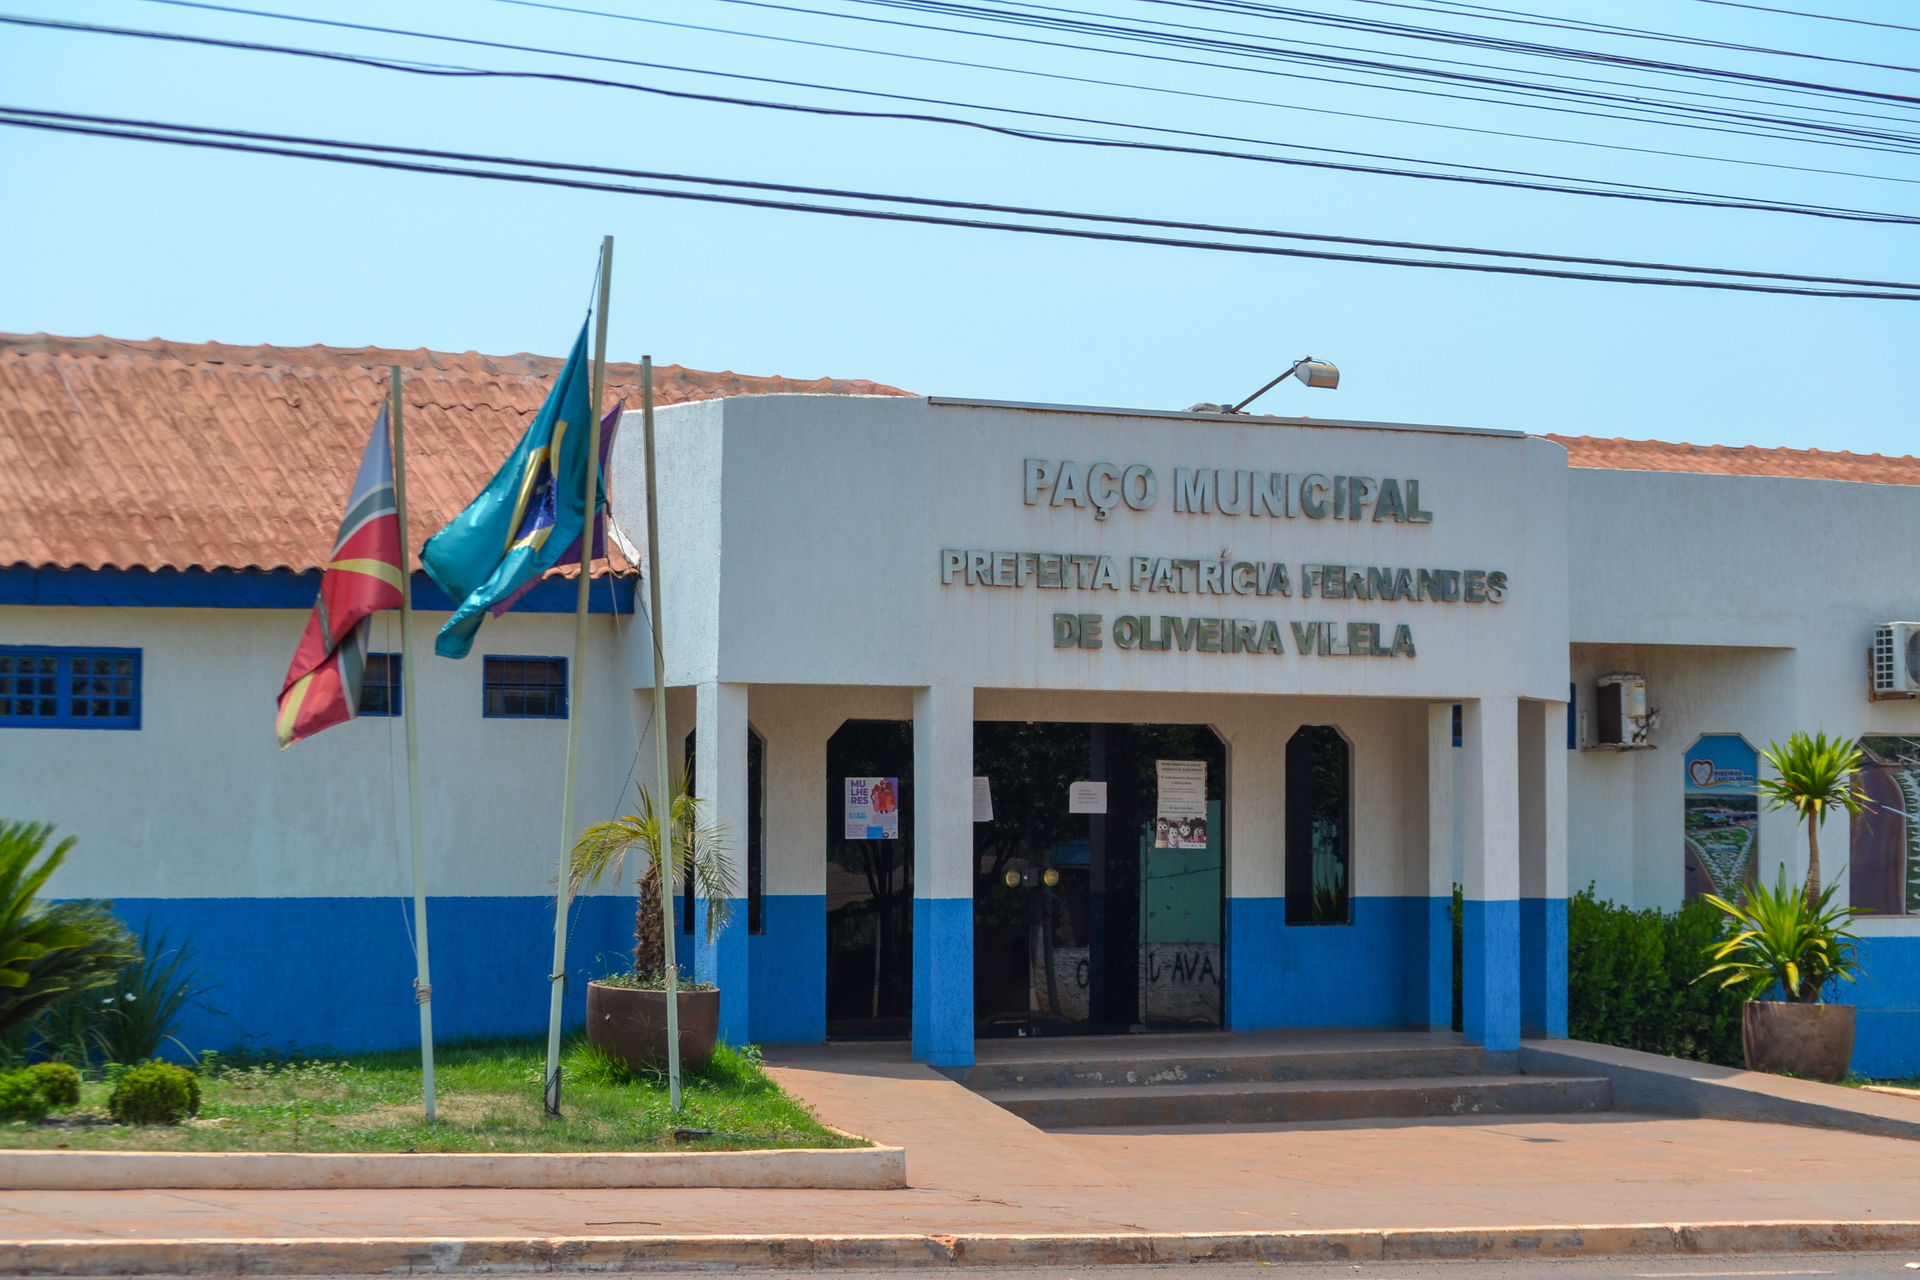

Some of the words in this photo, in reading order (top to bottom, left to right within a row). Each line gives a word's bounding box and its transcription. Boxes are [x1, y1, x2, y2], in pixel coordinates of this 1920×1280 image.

[1023, 457, 1158, 521] PAÇO
[1173, 467, 1433, 523] MUNICIPAL
[941, 549, 1120, 591] PREFEITA
[1130, 546, 1293, 597] PATRÍCIA
[1302, 563, 1509, 604] FERNANDES
[1053, 613, 1103, 649] DE
[1112, 615, 1286, 656] OLIVEIRA
[1290, 621, 1417, 658] VILELA
[850, 780, 866, 788] MU
[850, 788, 868, 796] LHE
[850, 797, 868, 805] RES
